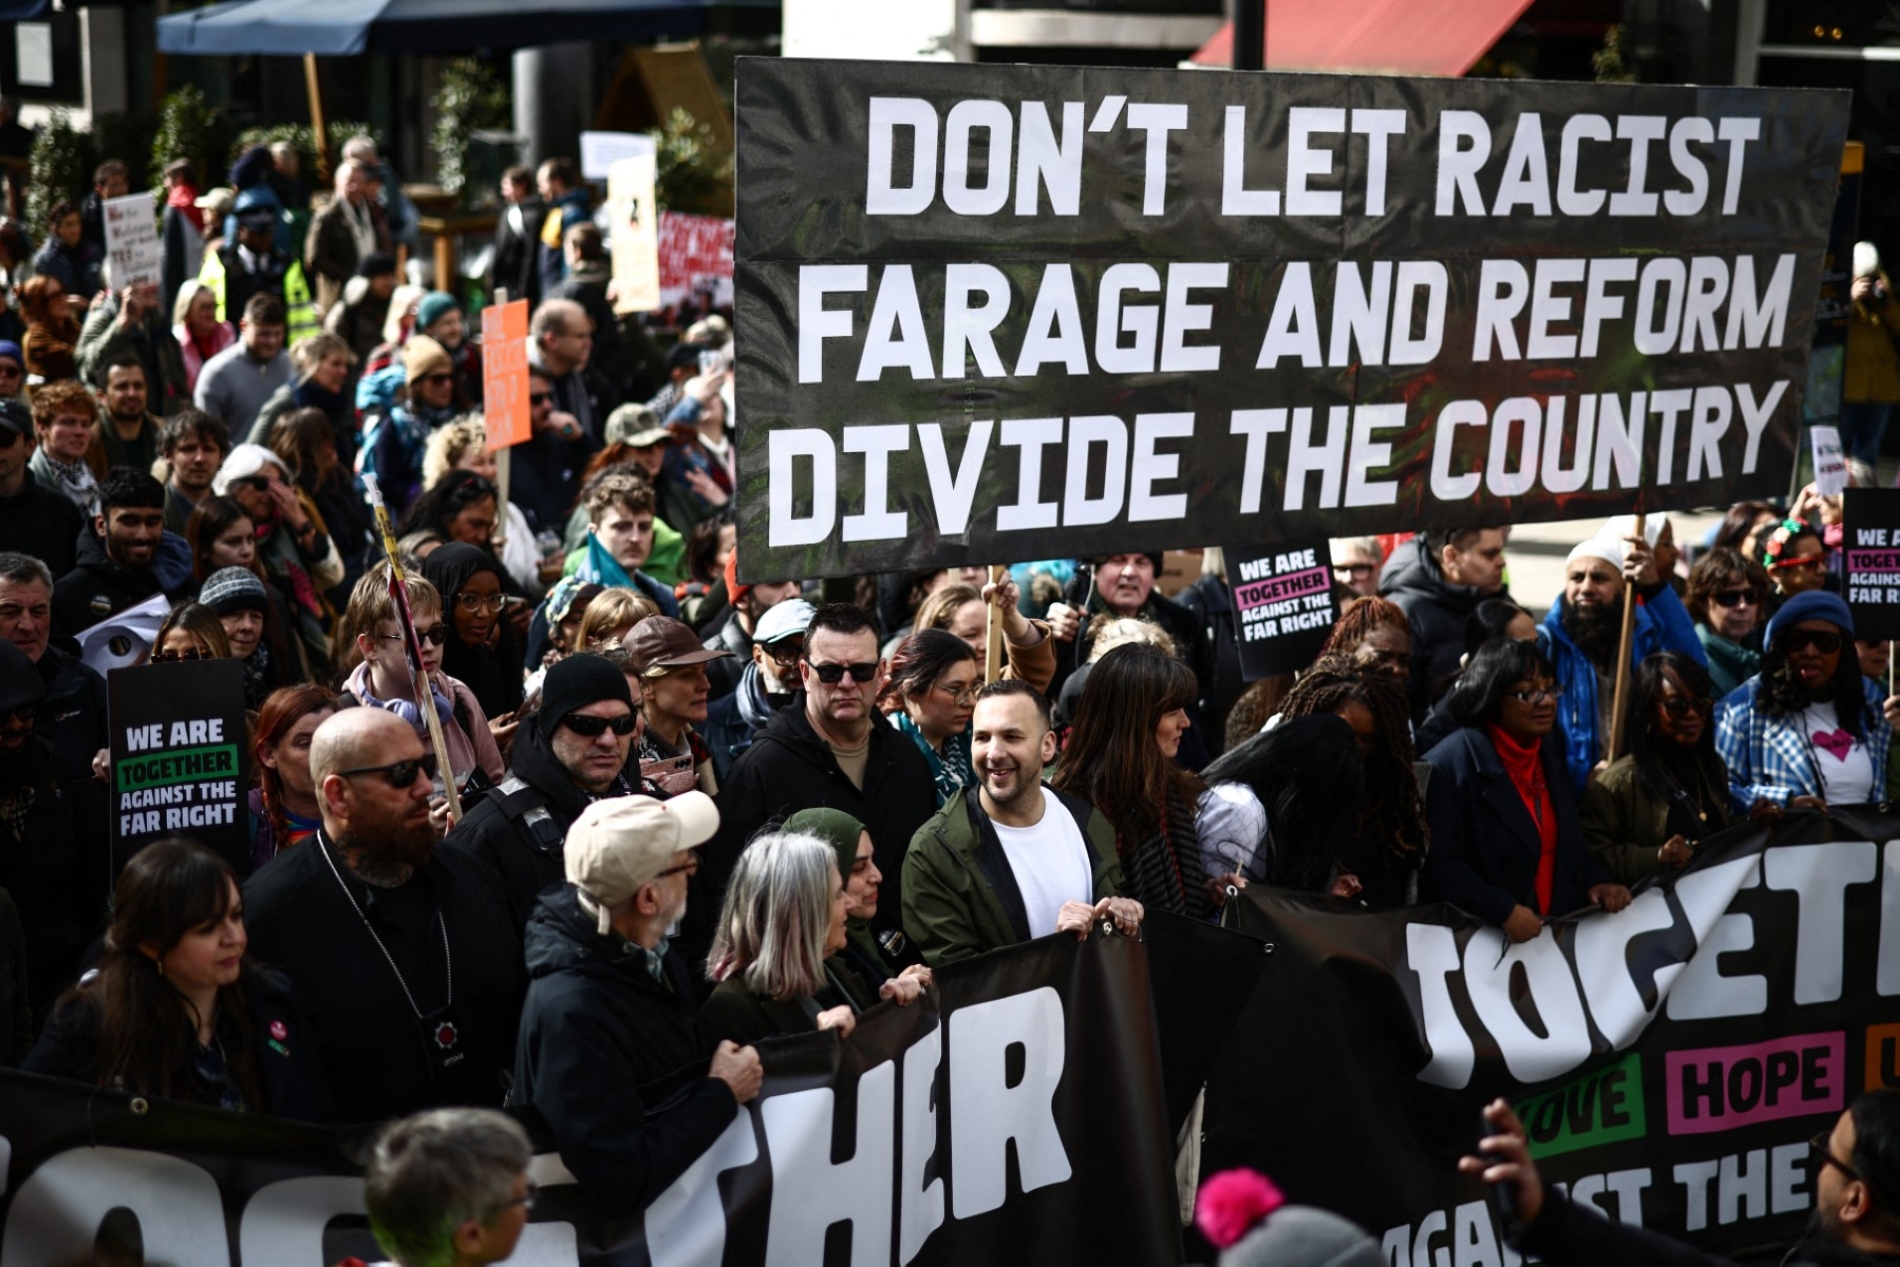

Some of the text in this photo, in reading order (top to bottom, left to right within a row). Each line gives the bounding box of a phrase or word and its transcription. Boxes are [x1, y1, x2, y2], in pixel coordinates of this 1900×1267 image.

[866, 95, 1761, 217] DON'T LET RACIST
[798, 262, 1229, 384] FARAGE
[1255, 260, 1449, 369] AND
[1472, 253, 1796, 362] REFORM
[768, 380, 1790, 547] DIVIDE THE COUNTRY
[1856, 528, 1888, 547] WE
[1239, 548, 1317, 582] WE ARE
[1239, 571, 1326, 606] TOGETHER
[1849, 587, 1883, 604] FAR
[1241, 592, 1332, 624] AGAINST THE
[1243, 607, 1333, 642] FAR RIGHT
[126, 718, 224, 752] WE ARE
[122, 750, 233, 786] TOGETHER
[120, 781, 237, 811] AGAINST THE
[120, 803, 237, 837] FAR RIGHT
[1406, 839, 1900, 1089] TOGET
[1681, 1045, 1831, 1121] HOPE
[1673, 1141, 1810, 1233] THE
